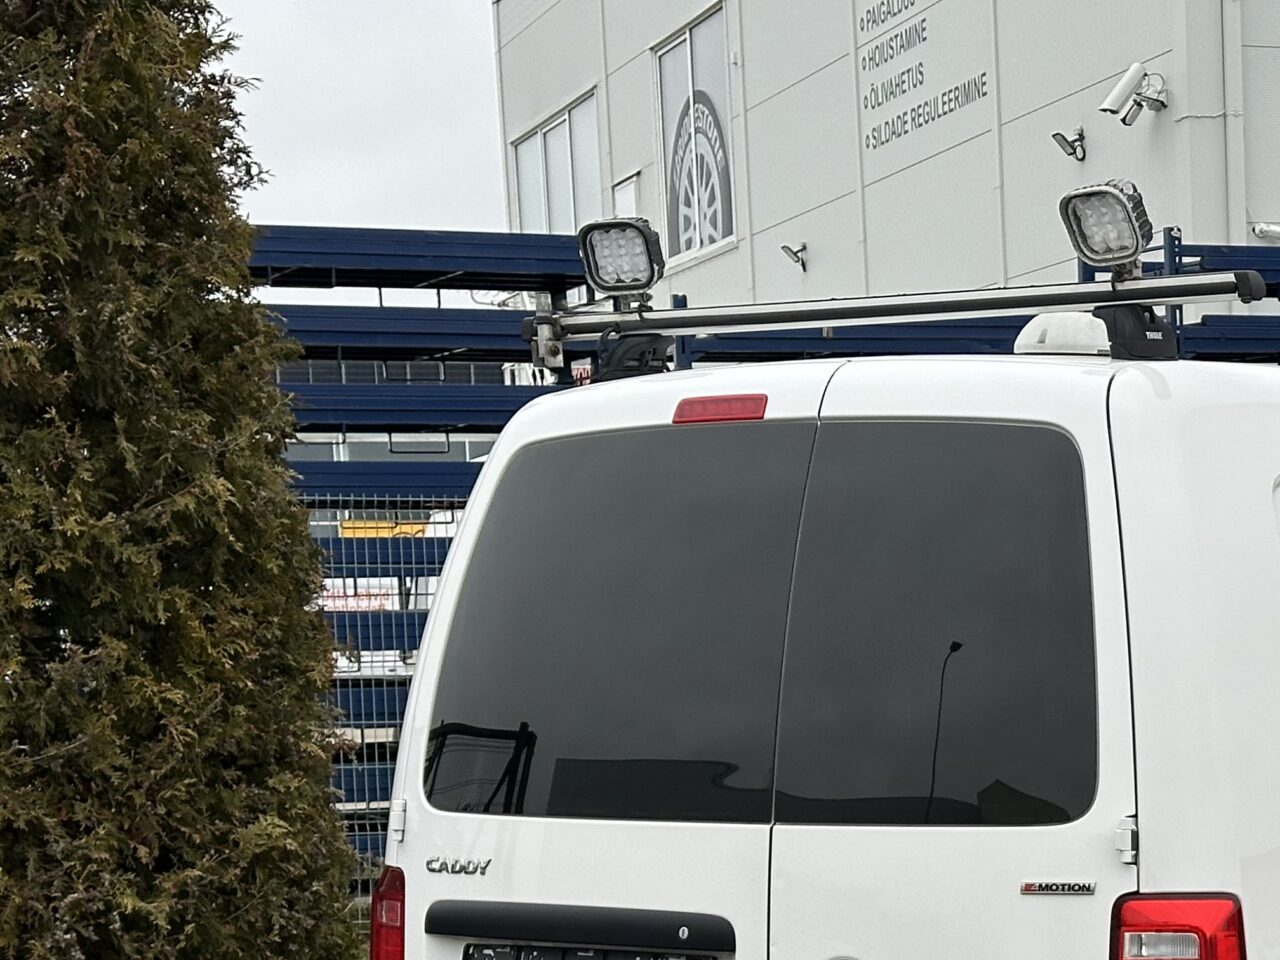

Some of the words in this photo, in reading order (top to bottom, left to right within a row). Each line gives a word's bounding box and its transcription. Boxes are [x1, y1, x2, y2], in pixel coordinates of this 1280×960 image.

[868, 17, 927, 71] HOIUSTAMINE
[869, 62, 924, 110] ÕLIVAHETUS
[871, 111, 909, 150] SILDADE
[910, 72, 988, 131] REGULEERIMINE
[426, 856, 492, 876] CADDY
